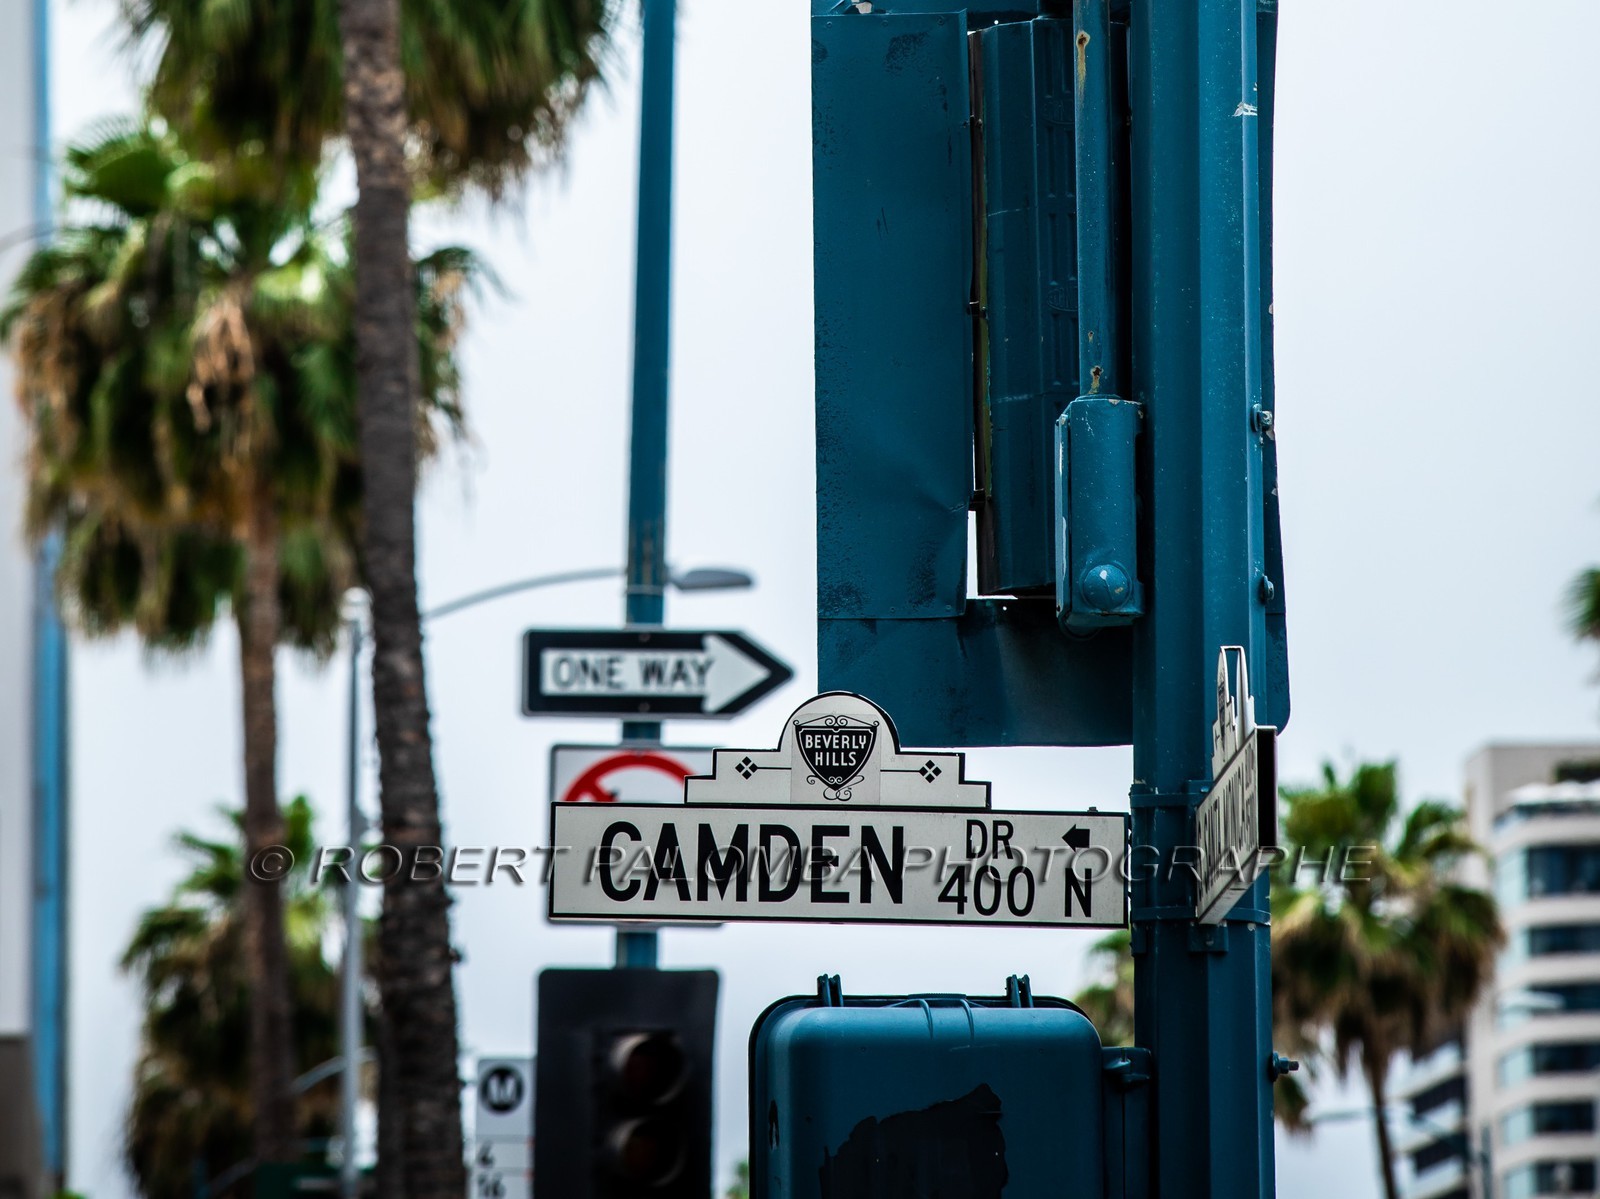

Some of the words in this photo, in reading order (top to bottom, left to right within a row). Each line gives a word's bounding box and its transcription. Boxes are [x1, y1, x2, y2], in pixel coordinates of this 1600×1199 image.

[552, 655, 628, 689] ONE
[638, 655, 716, 687] WAY
[805, 734, 867, 750] BEVERLY
[815, 751, 857, 767] HILLS
[966, 819, 1014, 859] DR
[600, 821, 904, 904] CAMDEN
[938, 865, 1035, 917] 400
[1064, 867, 1092, 917] N
